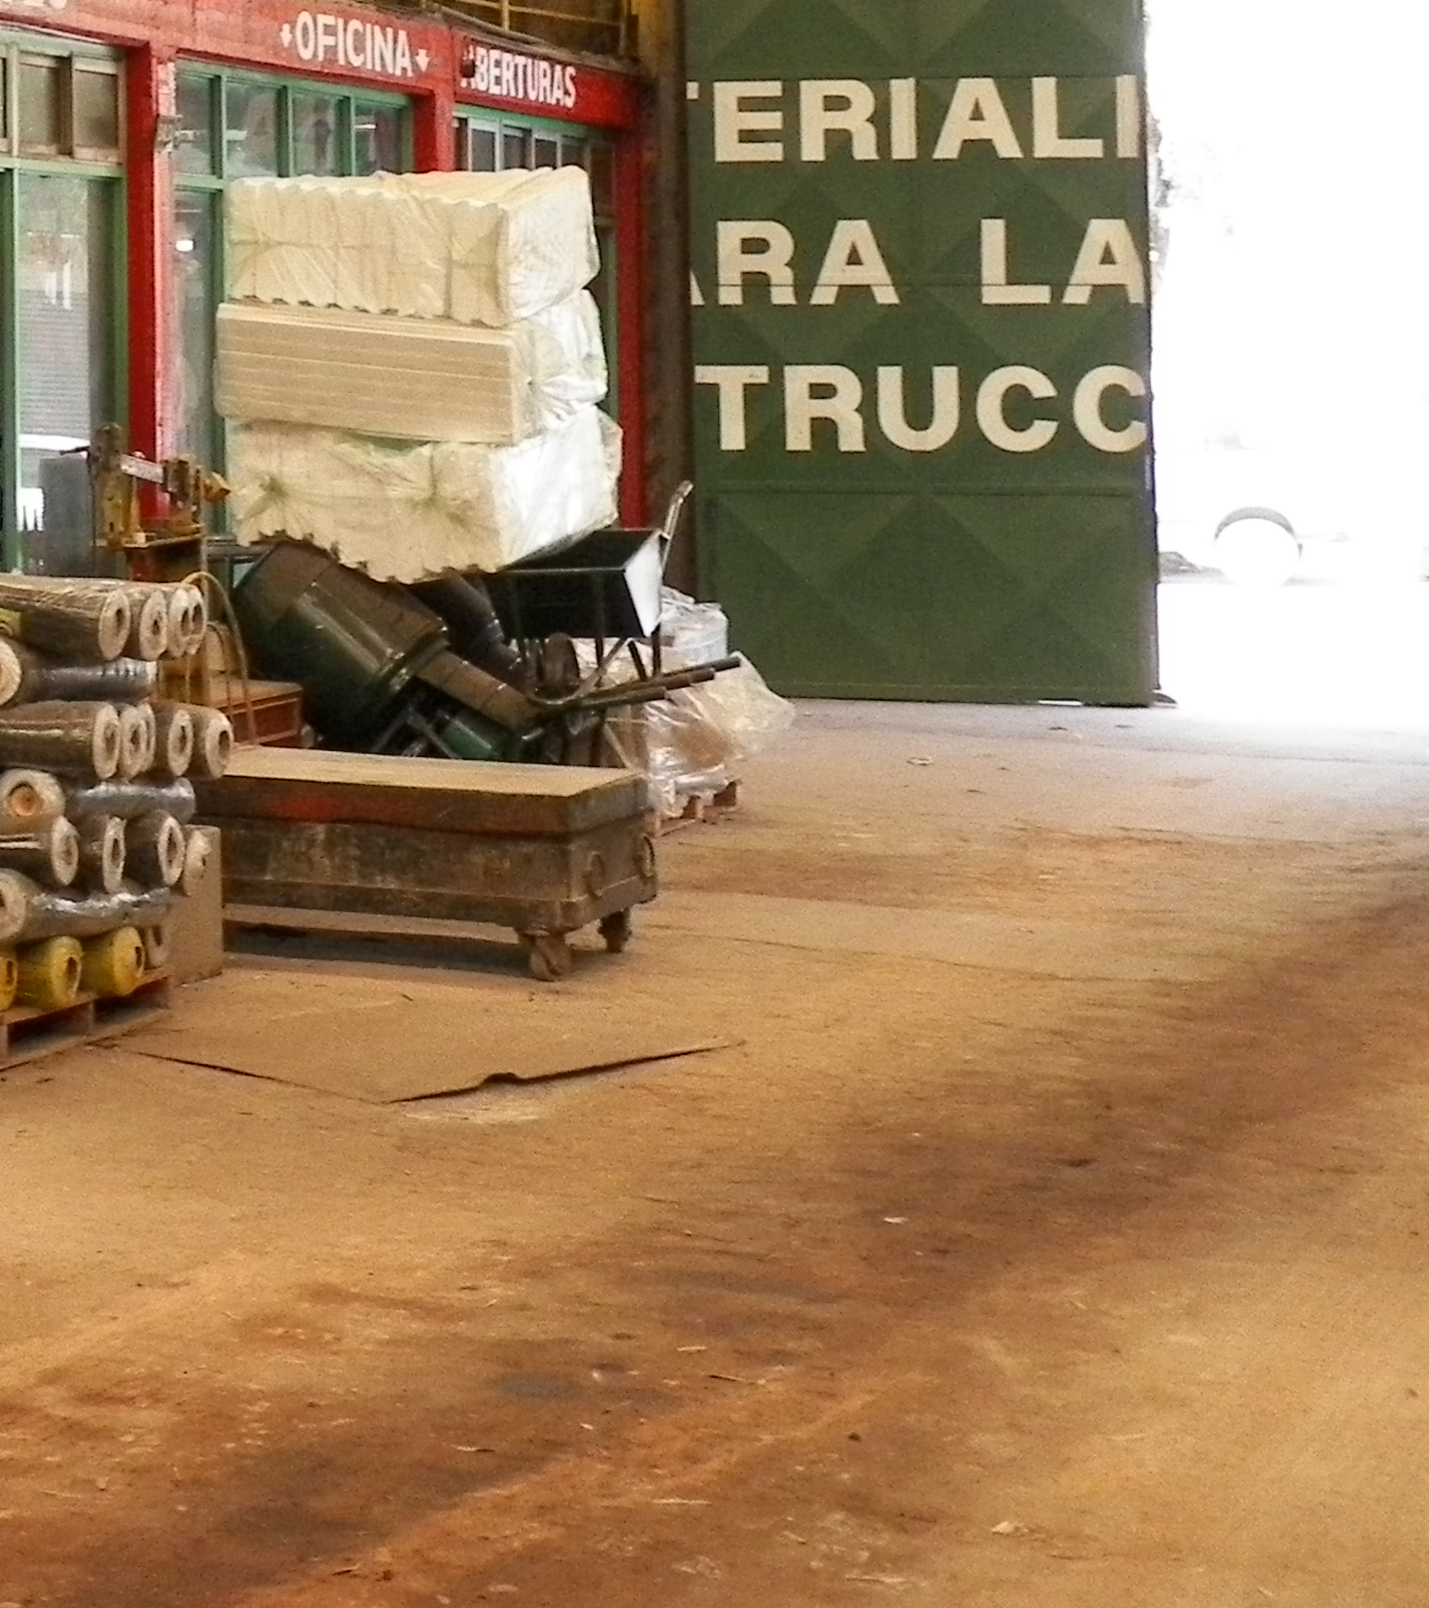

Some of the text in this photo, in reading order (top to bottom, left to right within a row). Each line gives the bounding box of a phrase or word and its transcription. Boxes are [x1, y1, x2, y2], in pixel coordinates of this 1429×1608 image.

[295, 10, 414, 77] OFICINA
[690, 218, 1144, 305] RA LA
[694, 364, 1148, 452] TRUCC
